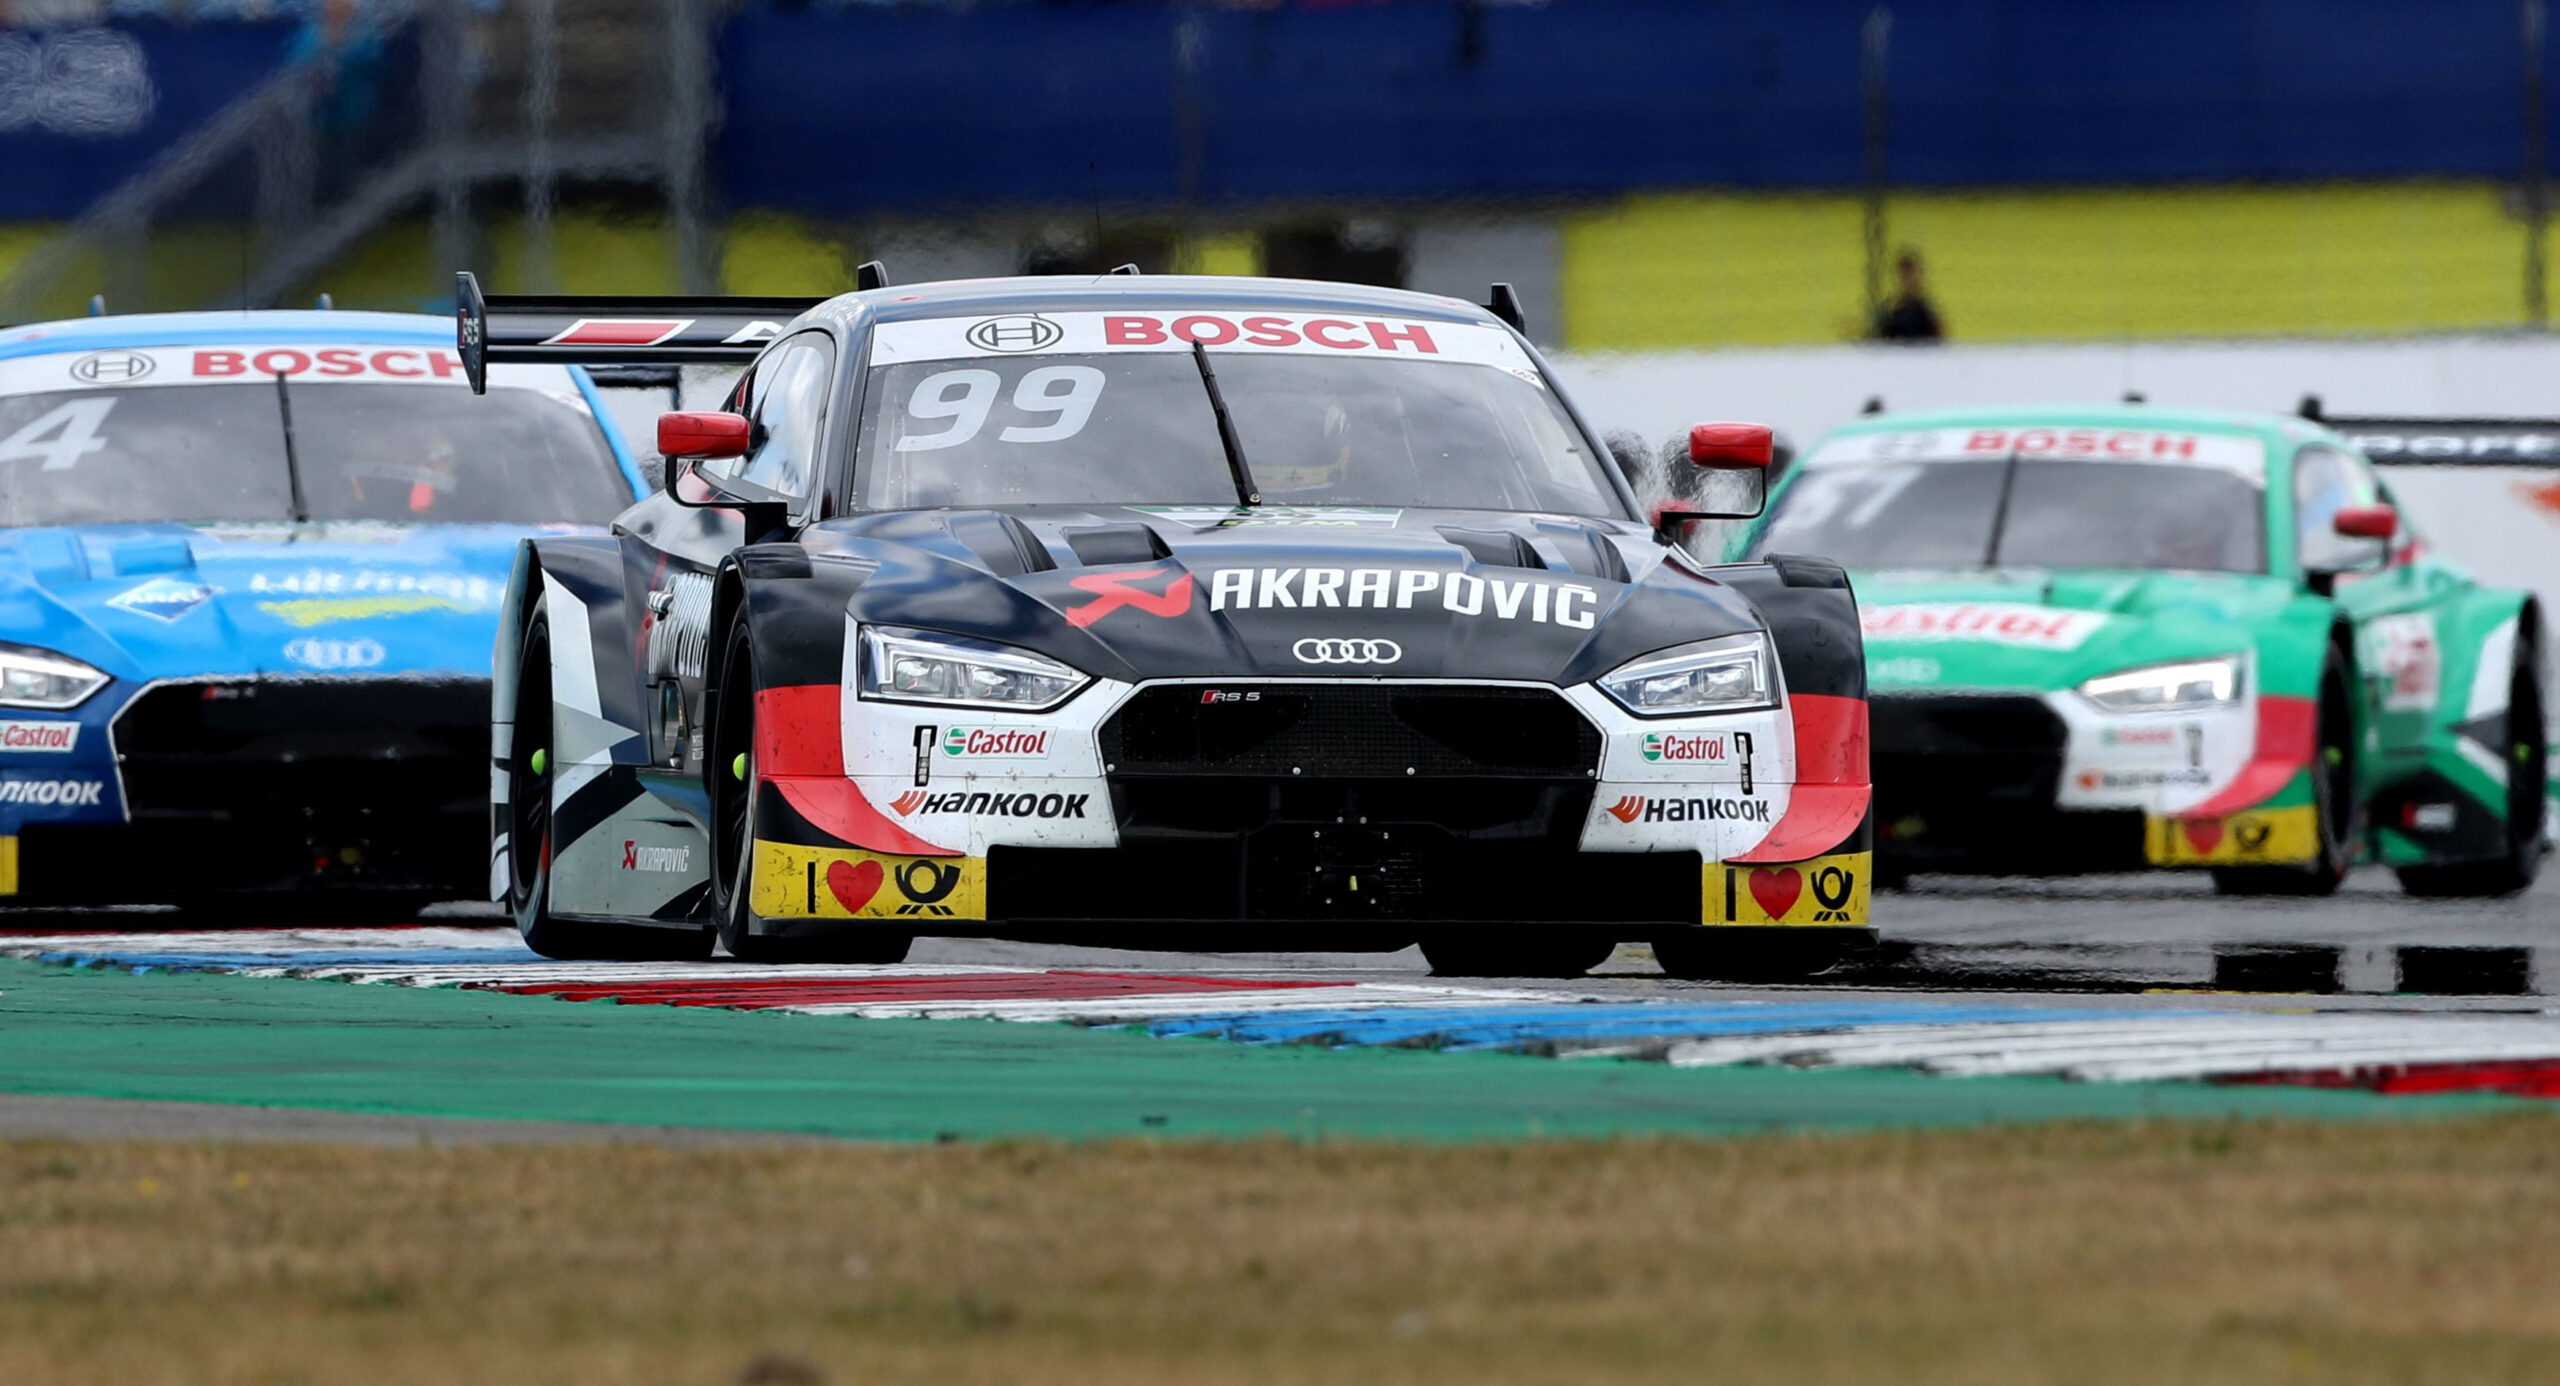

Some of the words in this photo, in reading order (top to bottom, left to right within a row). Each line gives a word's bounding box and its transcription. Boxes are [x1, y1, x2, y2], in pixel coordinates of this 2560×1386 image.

[1103, 315, 1438, 353] BOSCH
[895, 365, 1106, 452] 99
[0, 396, 119, 472] 4
[1964, 430, 2197, 459] BOSCH
[1245, 691, 1261, 702] 5
[4, 724, 72, 747] Castrol
[967, 728, 1048, 755] Castrol
[1663, 735, 1726, 760] Castrol
